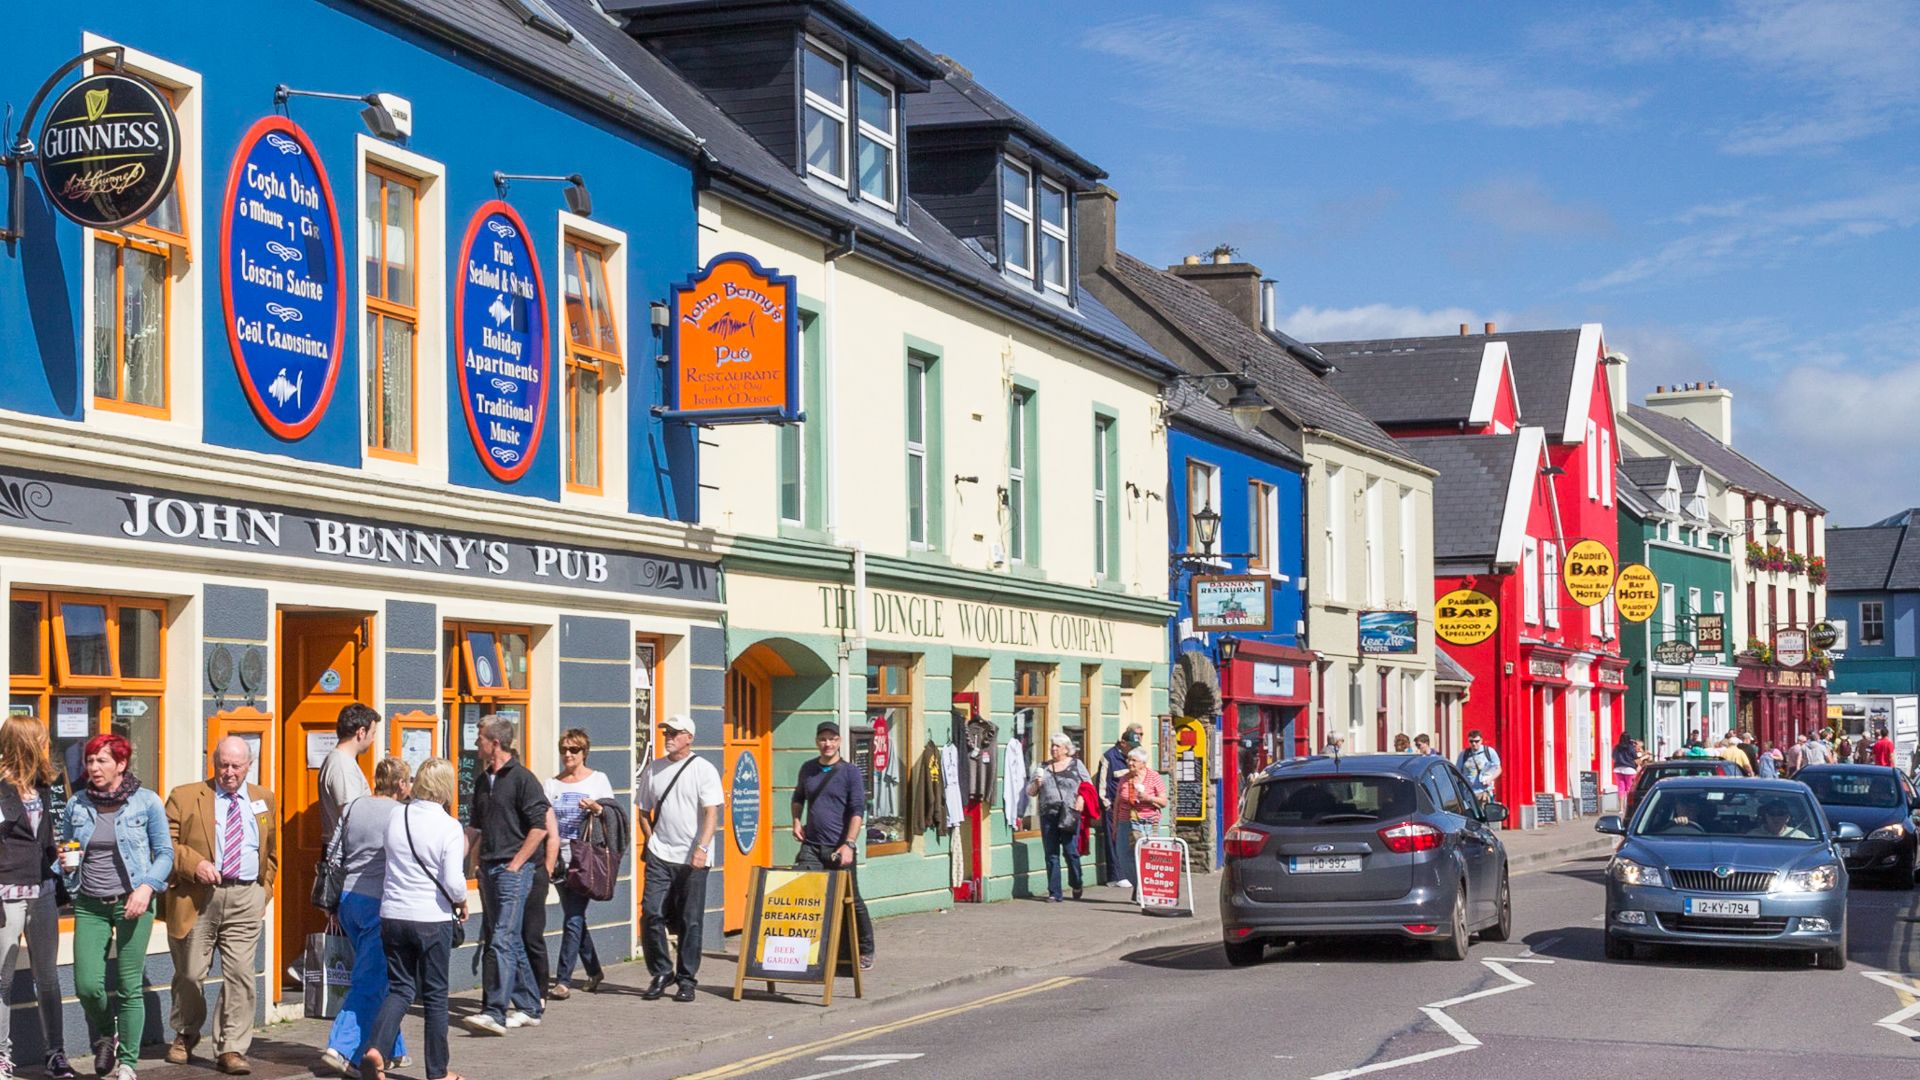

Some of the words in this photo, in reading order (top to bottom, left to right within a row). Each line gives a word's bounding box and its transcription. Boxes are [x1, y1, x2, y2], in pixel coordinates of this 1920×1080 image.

[44, 121, 160, 158] GUINNESS
[493, 241, 514, 266] Fine
[469, 259, 500, 290] Seafood
[501, 270, 508, 293] &
[510, 272, 534, 300] Steaks
[682, 292, 720, 328] John
[722, 282, 784, 324] Benny's
[482, 326, 522, 361] Holiday
[714, 346, 752, 368] Pub
[465, 347, 539, 383] Apartments
[476, 393, 533, 423] Traditional
[490, 421, 520, 445] Music
[122, 492, 284, 547] JOHN
[315, 518, 510, 575] BENNY'S
[534, 545, 609, 583] PUB
[1570, 562, 1609, 576] BAR
[1576, 590, 1602, 598] HOTEL
[1619, 589, 1655, 599] HOTEL
[1439, 607, 1492, 618] BAR
[873, 592, 944, 639] DINGLE
[958, 603, 1040, 648] WOOLLEN
[1051, 614, 1116, 654] COMPANY
[1145, 862, 1174, 872] Bureau
[1144, 877, 1174, 888] Change
[768, 896, 791, 906] FULL
[794, 897, 821, 907] IRISH
[1698, 902, 1750, 914] 12-KY-1794
[764, 912, 822, 922] BREAKFAST
[763, 927, 784, 937] ALL
[788, 928, 817, 938] DAY!!
[774, 946, 795, 954] BEER
[767, 956, 800, 965] GARDEN
